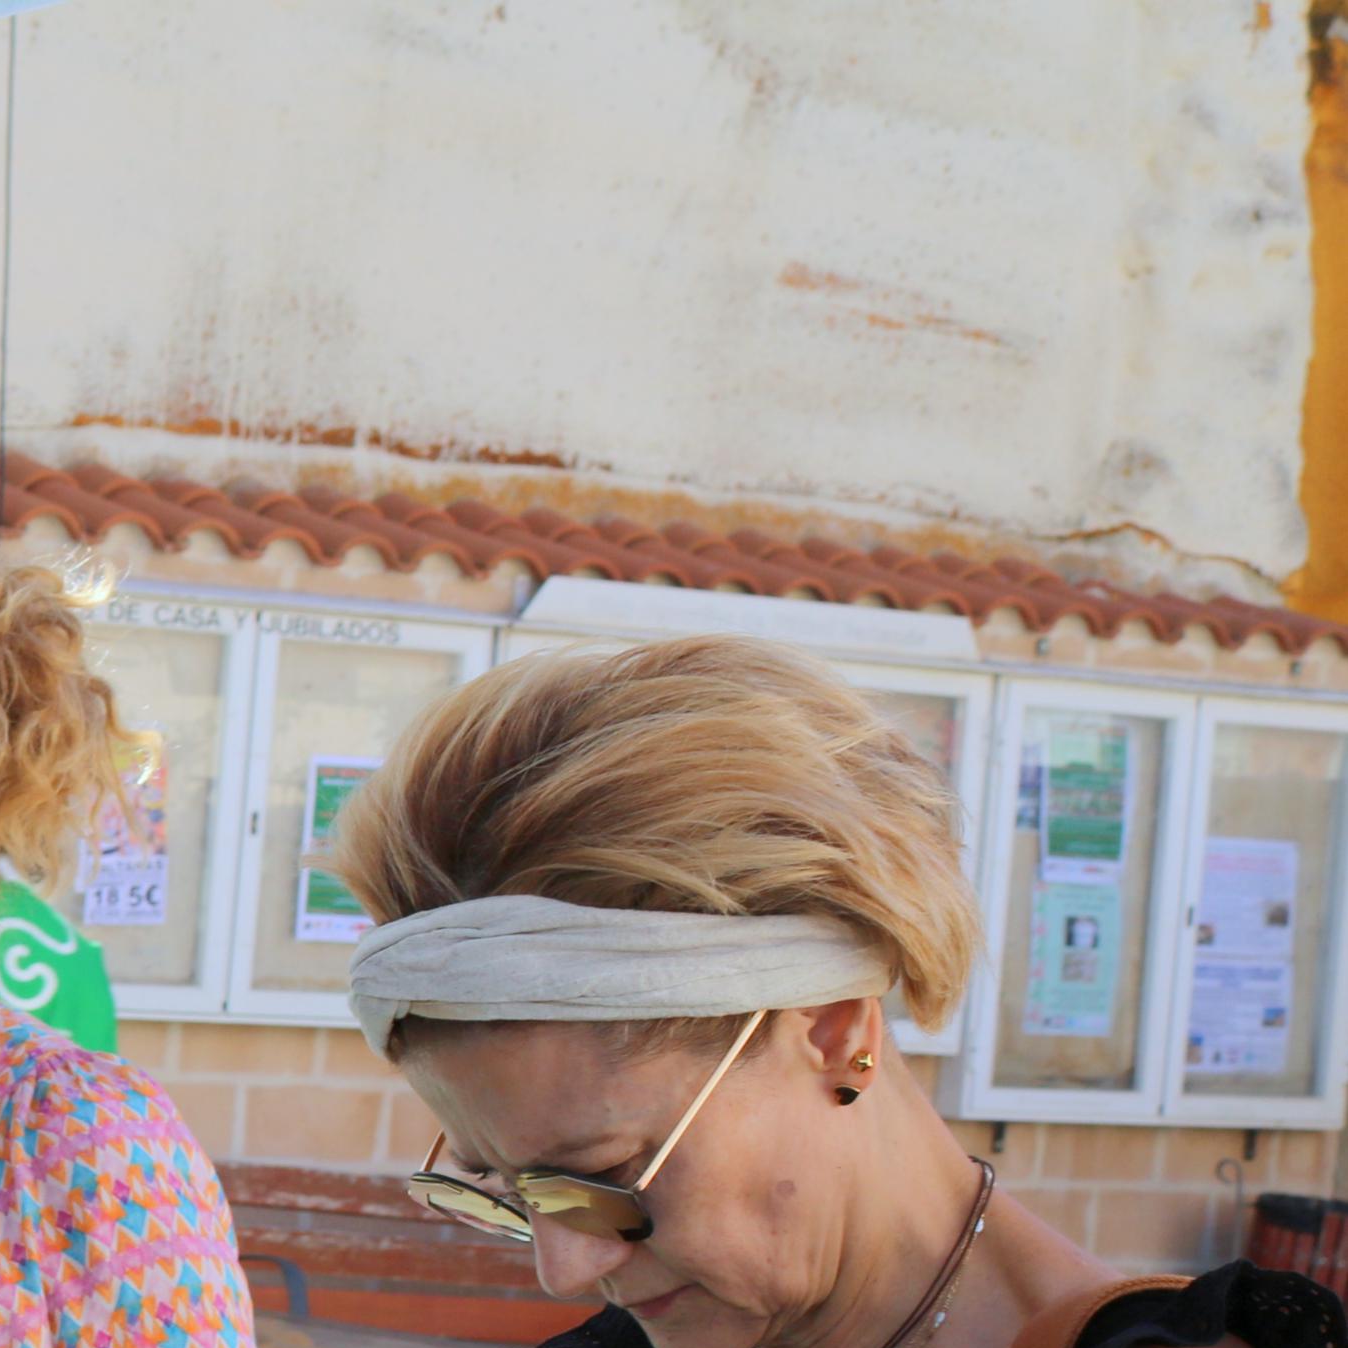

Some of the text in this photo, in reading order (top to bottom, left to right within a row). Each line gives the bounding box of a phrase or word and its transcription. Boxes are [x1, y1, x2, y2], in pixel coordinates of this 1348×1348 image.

[107, 602, 140, 622] DE
[153, 604, 221, 628] CASA
[235, 608, 247, 628] Y
[257, 609, 401, 644] JUBILADOS
